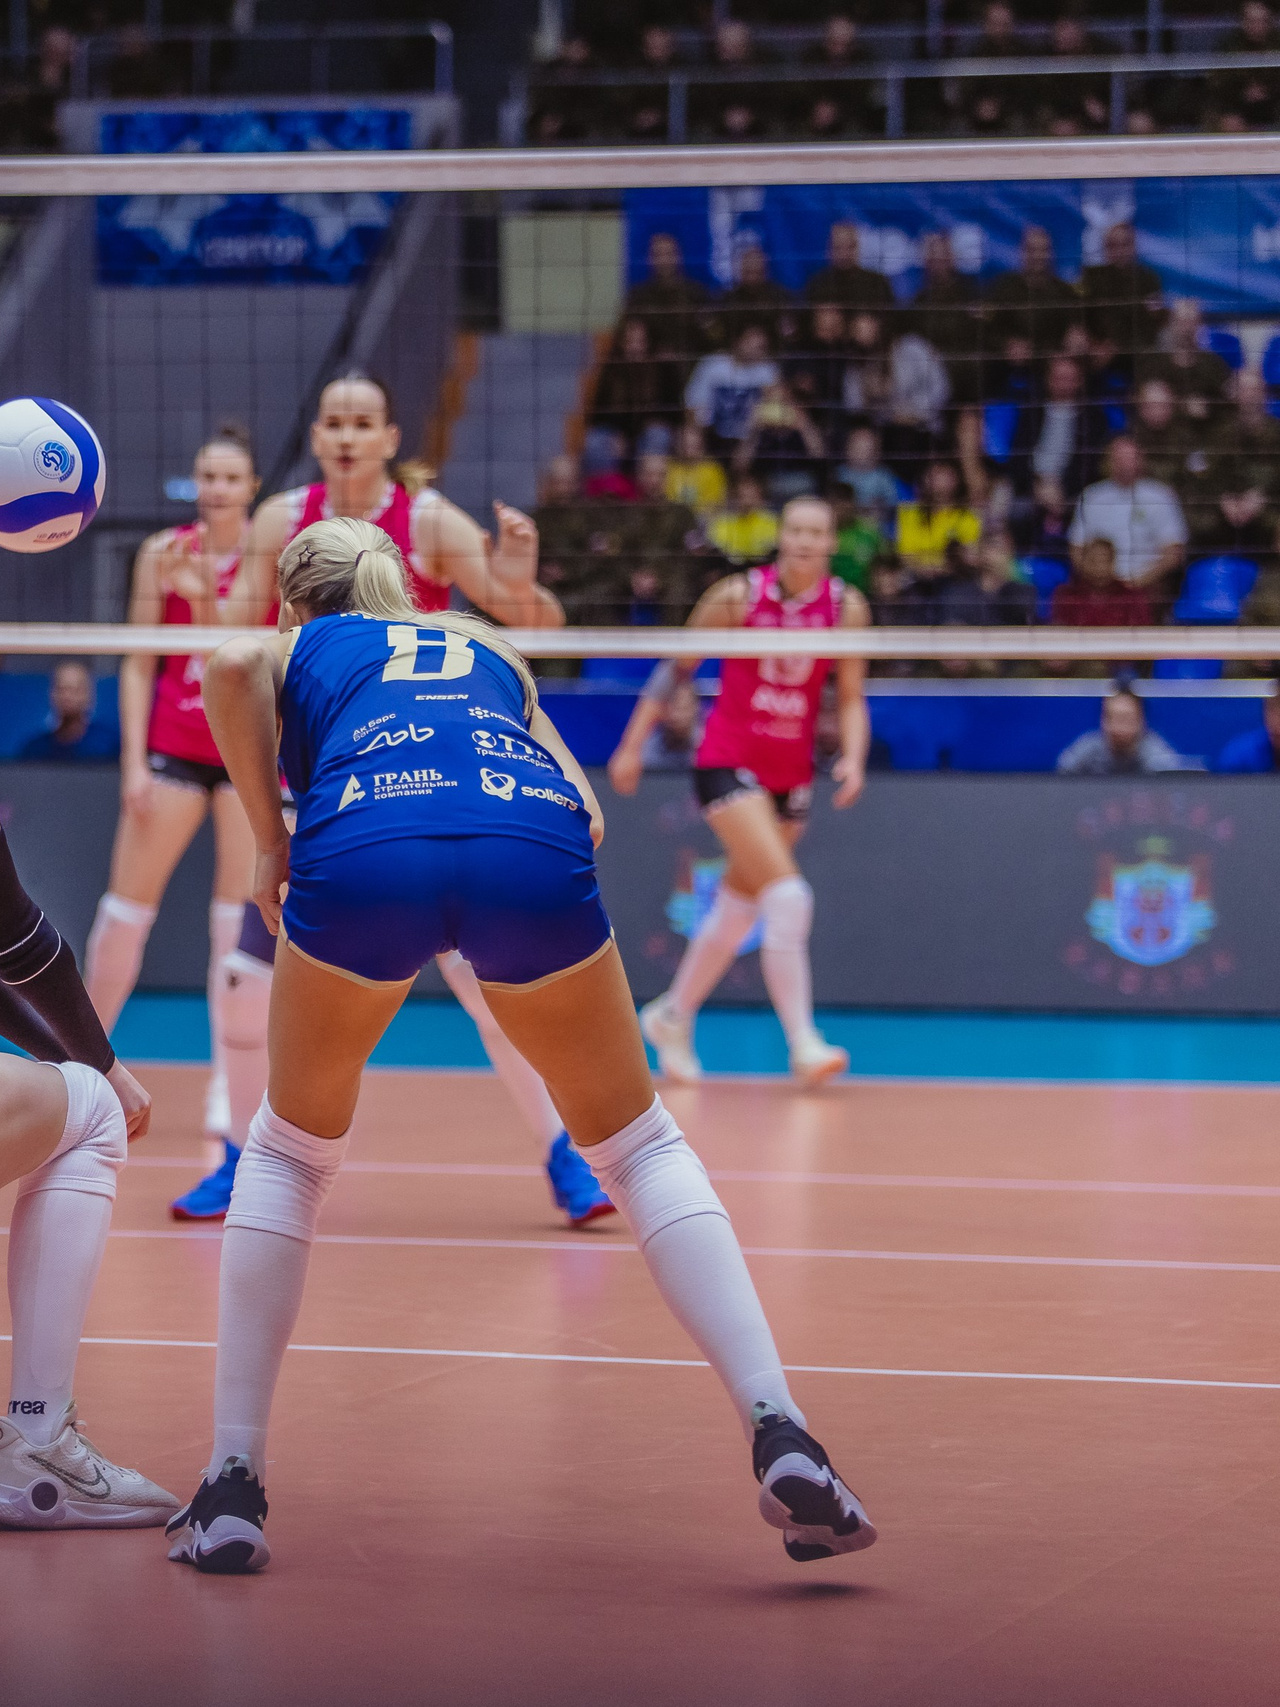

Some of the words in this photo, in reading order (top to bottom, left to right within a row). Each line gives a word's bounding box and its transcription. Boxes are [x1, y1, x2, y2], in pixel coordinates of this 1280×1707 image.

[368, 713, 396, 728] Барс
[373, 769, 443, 787] ГРАНЬ
[374, 781, 458, 793] строительная
[374, 788, 432, 800] компания
[521, 786, 578, 811] sollers
